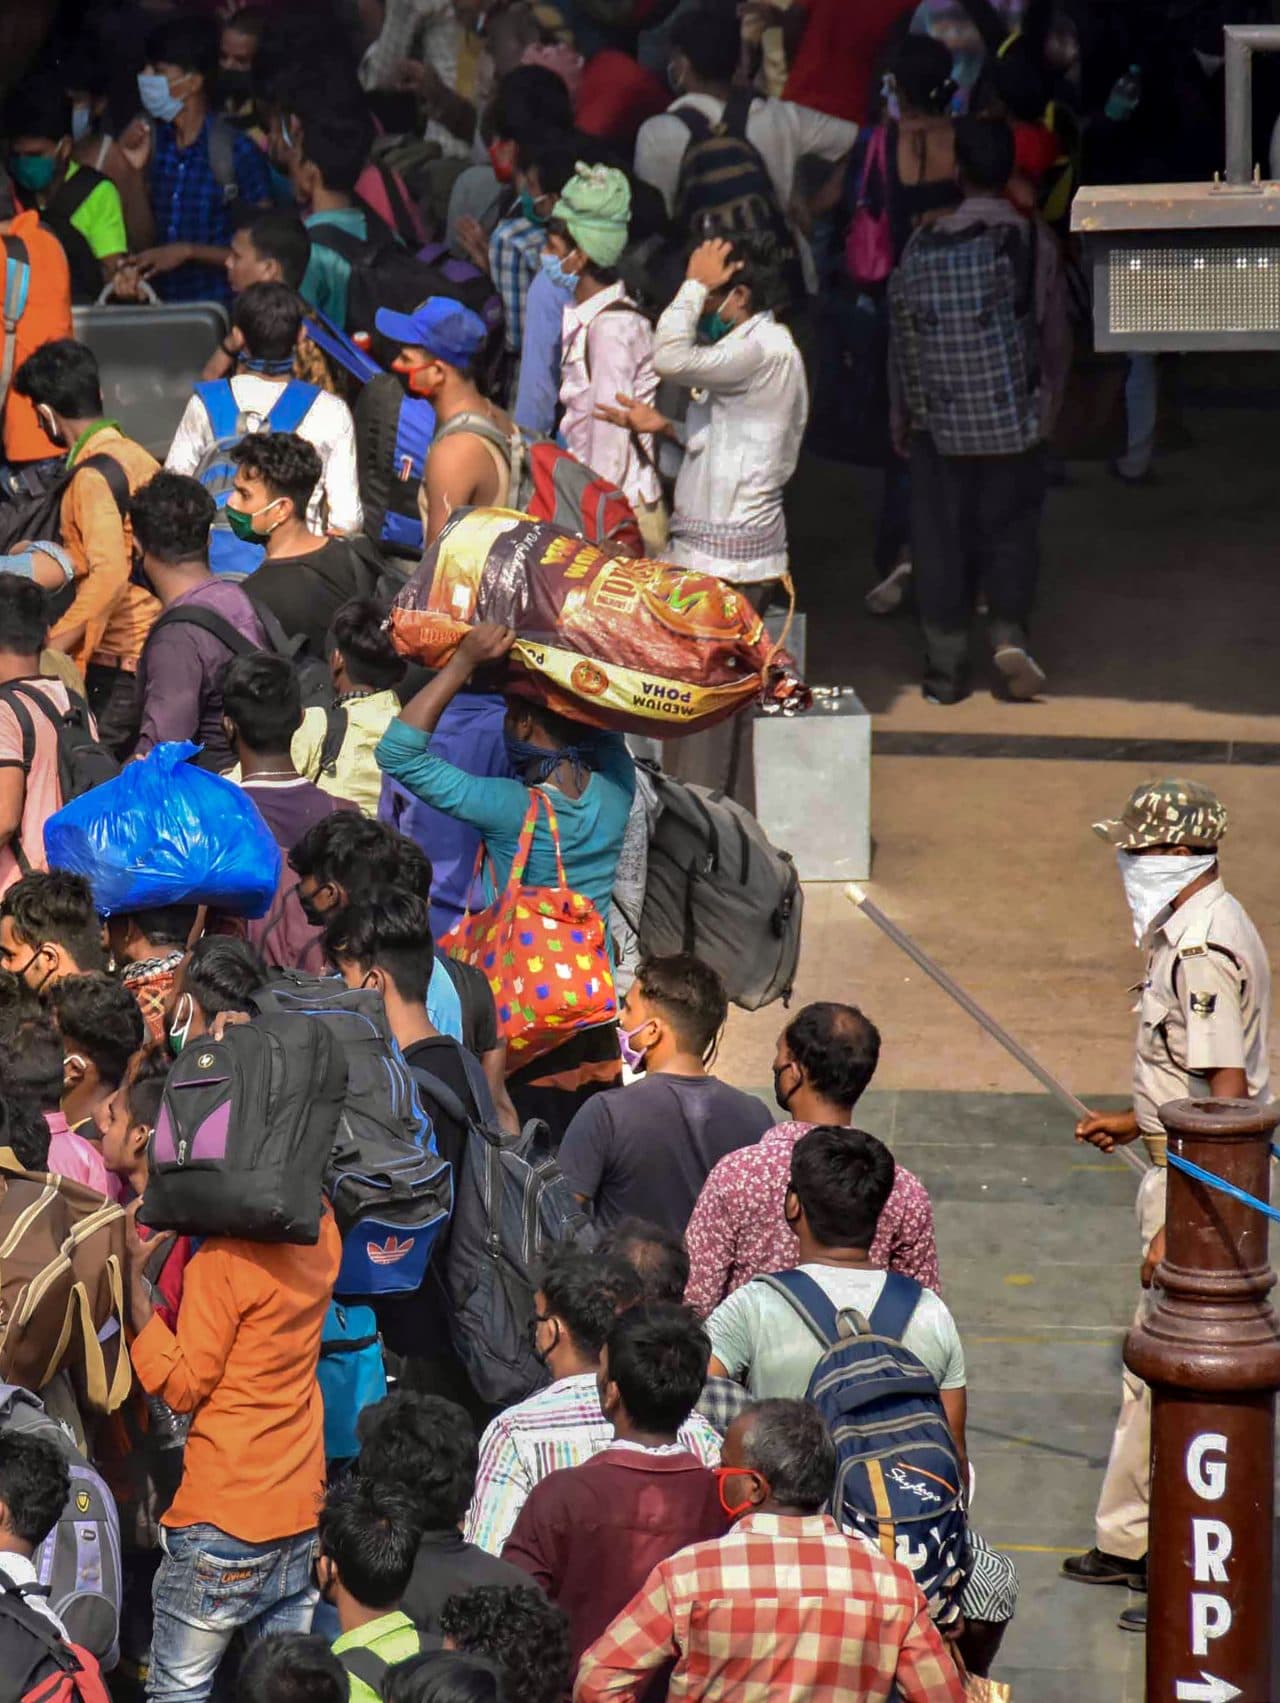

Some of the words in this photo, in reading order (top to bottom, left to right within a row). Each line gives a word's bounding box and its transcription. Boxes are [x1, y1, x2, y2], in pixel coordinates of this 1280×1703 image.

[642, 682, 691, 703] POHA
[633, 695, 694, 715] MEDIUM
[1186, 1432, 1233, 1656] GRP
